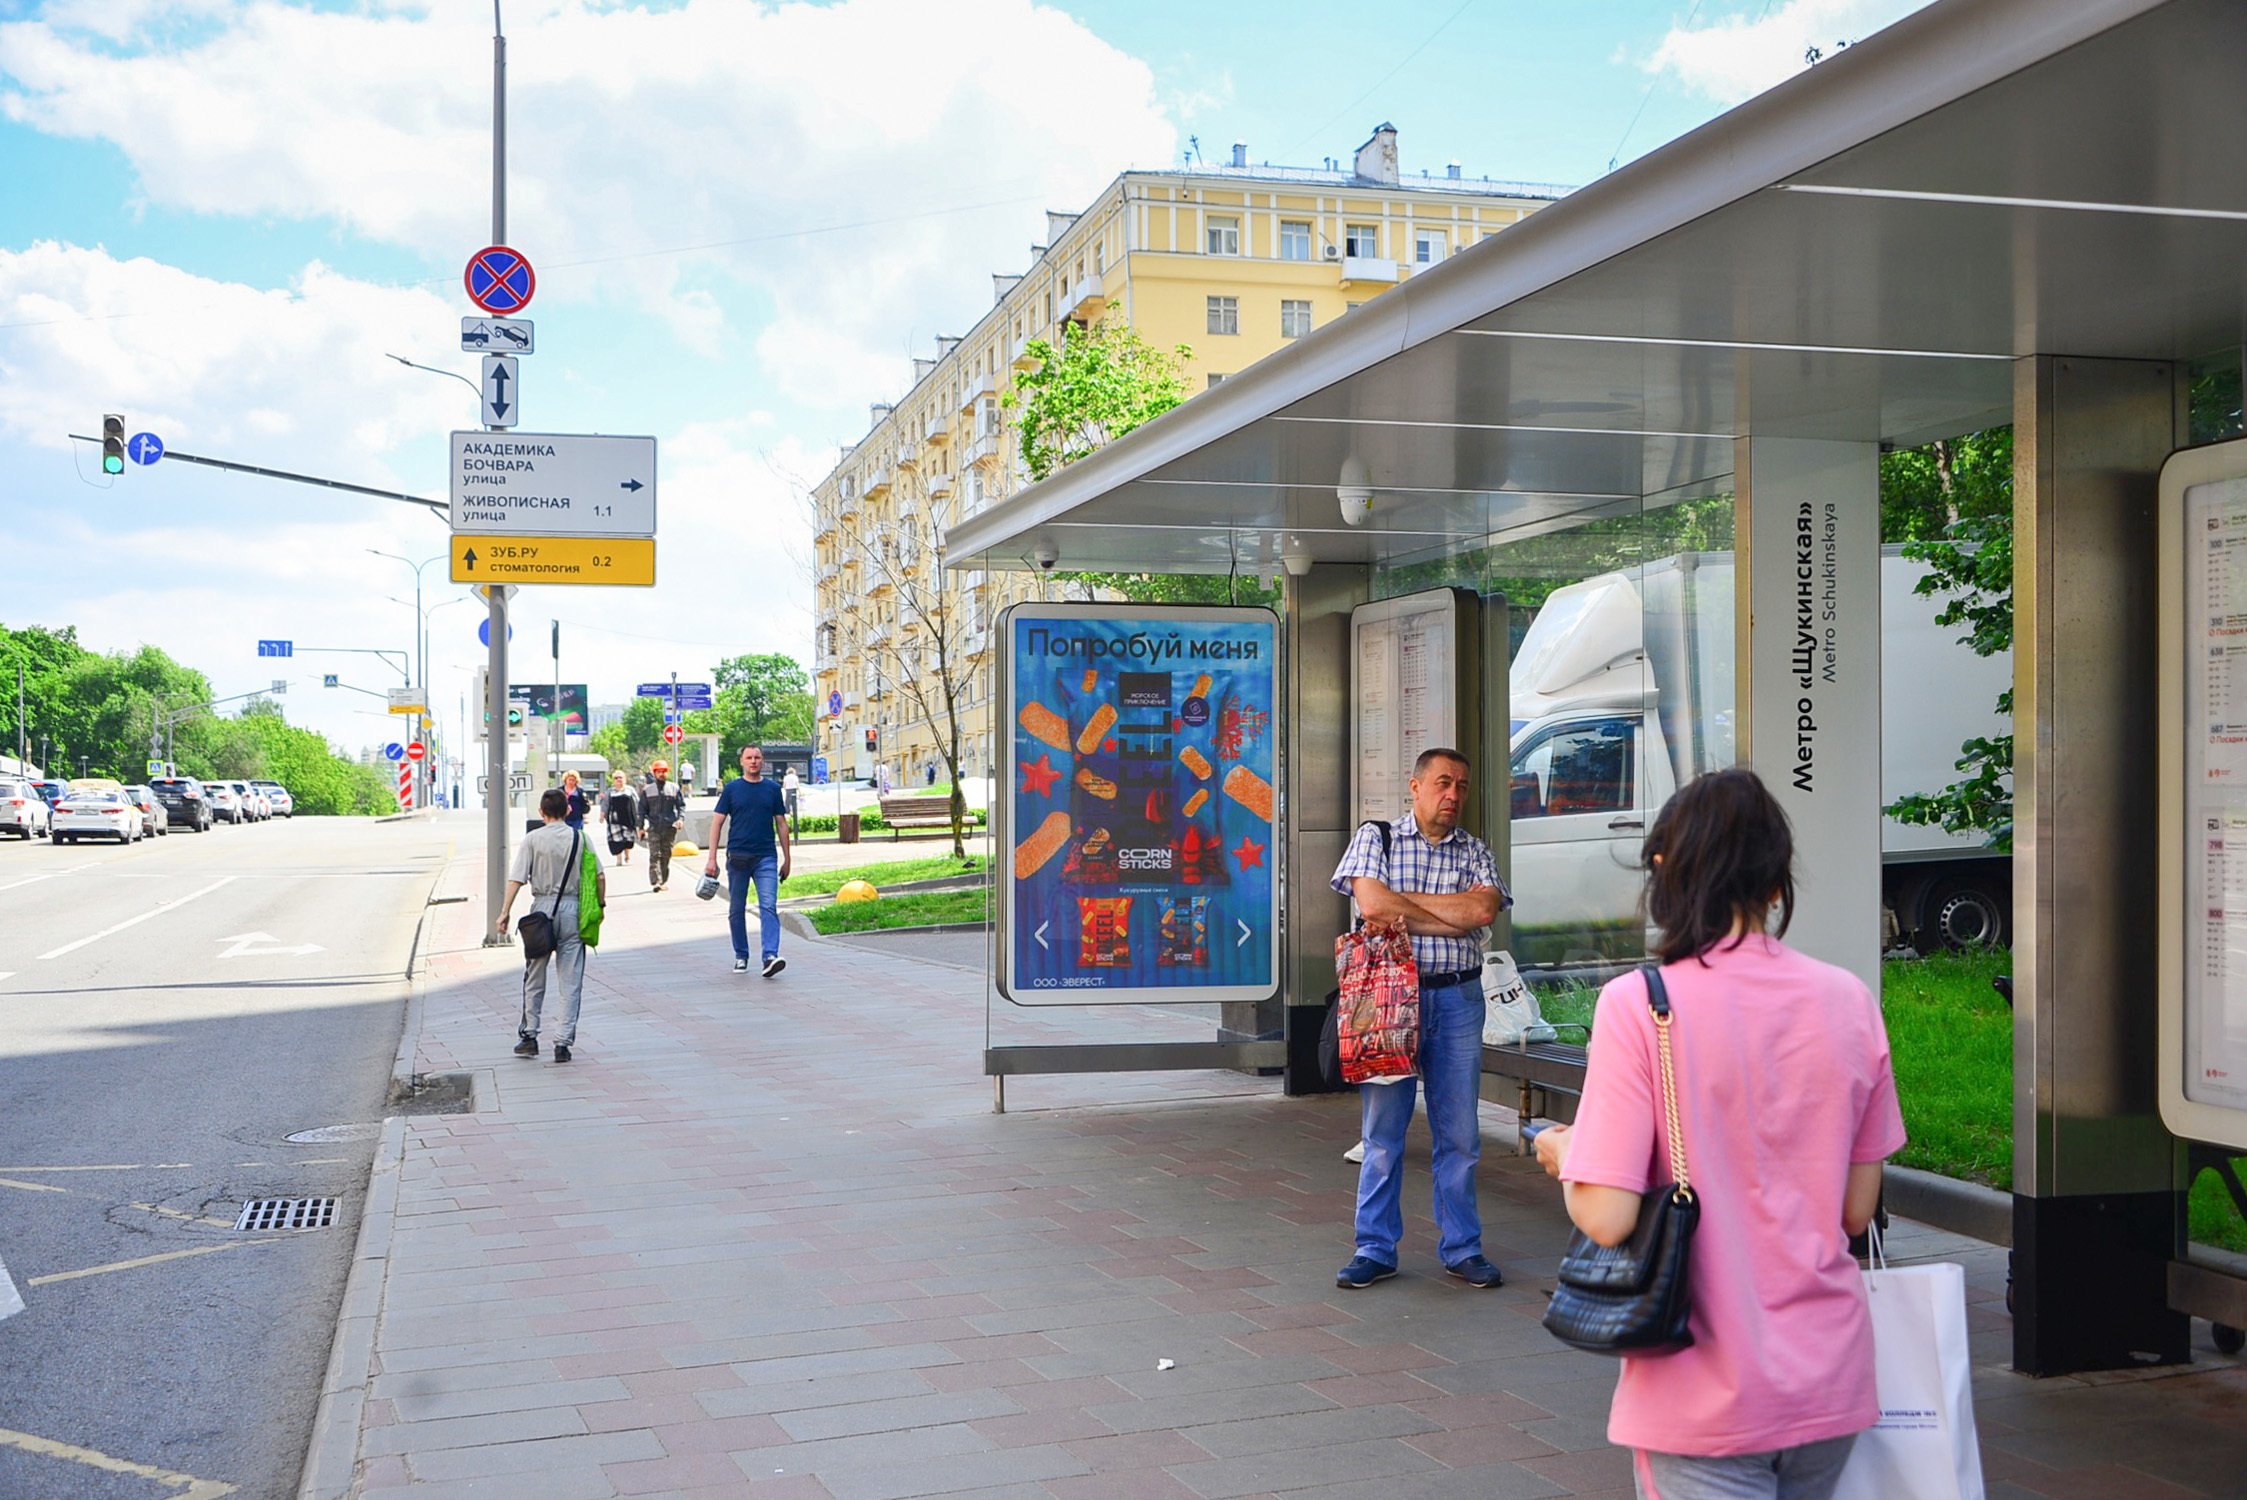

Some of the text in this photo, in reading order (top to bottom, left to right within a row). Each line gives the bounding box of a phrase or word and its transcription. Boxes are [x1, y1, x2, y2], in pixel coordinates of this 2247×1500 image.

[463, 443, 556, 457] АКАДЕМИКА
[463, 459, 534, 472] БОЧВАРА
[463, 474, 506, 486] улица
[463, 495, 612, 517] ЖИВОПИСНАЯ 1.1
[463, 510, 506, 522] улица
[490, 547, 612, 568] ЗУБ.РУ 0.2
[490, 562, 580, 574] стоматология
[1821, 503, 1839, 683] Metro Schukinskaya
[1028, 628, 1258, 665] Попробуй меня
[1792, 501, 1818, 793] Метро «Щукинская»
[1118, 848, 1172, 859] CORN
[1118, 859, 1172, 869] STICKS
[1033, 978, 1057, 987] ООО
